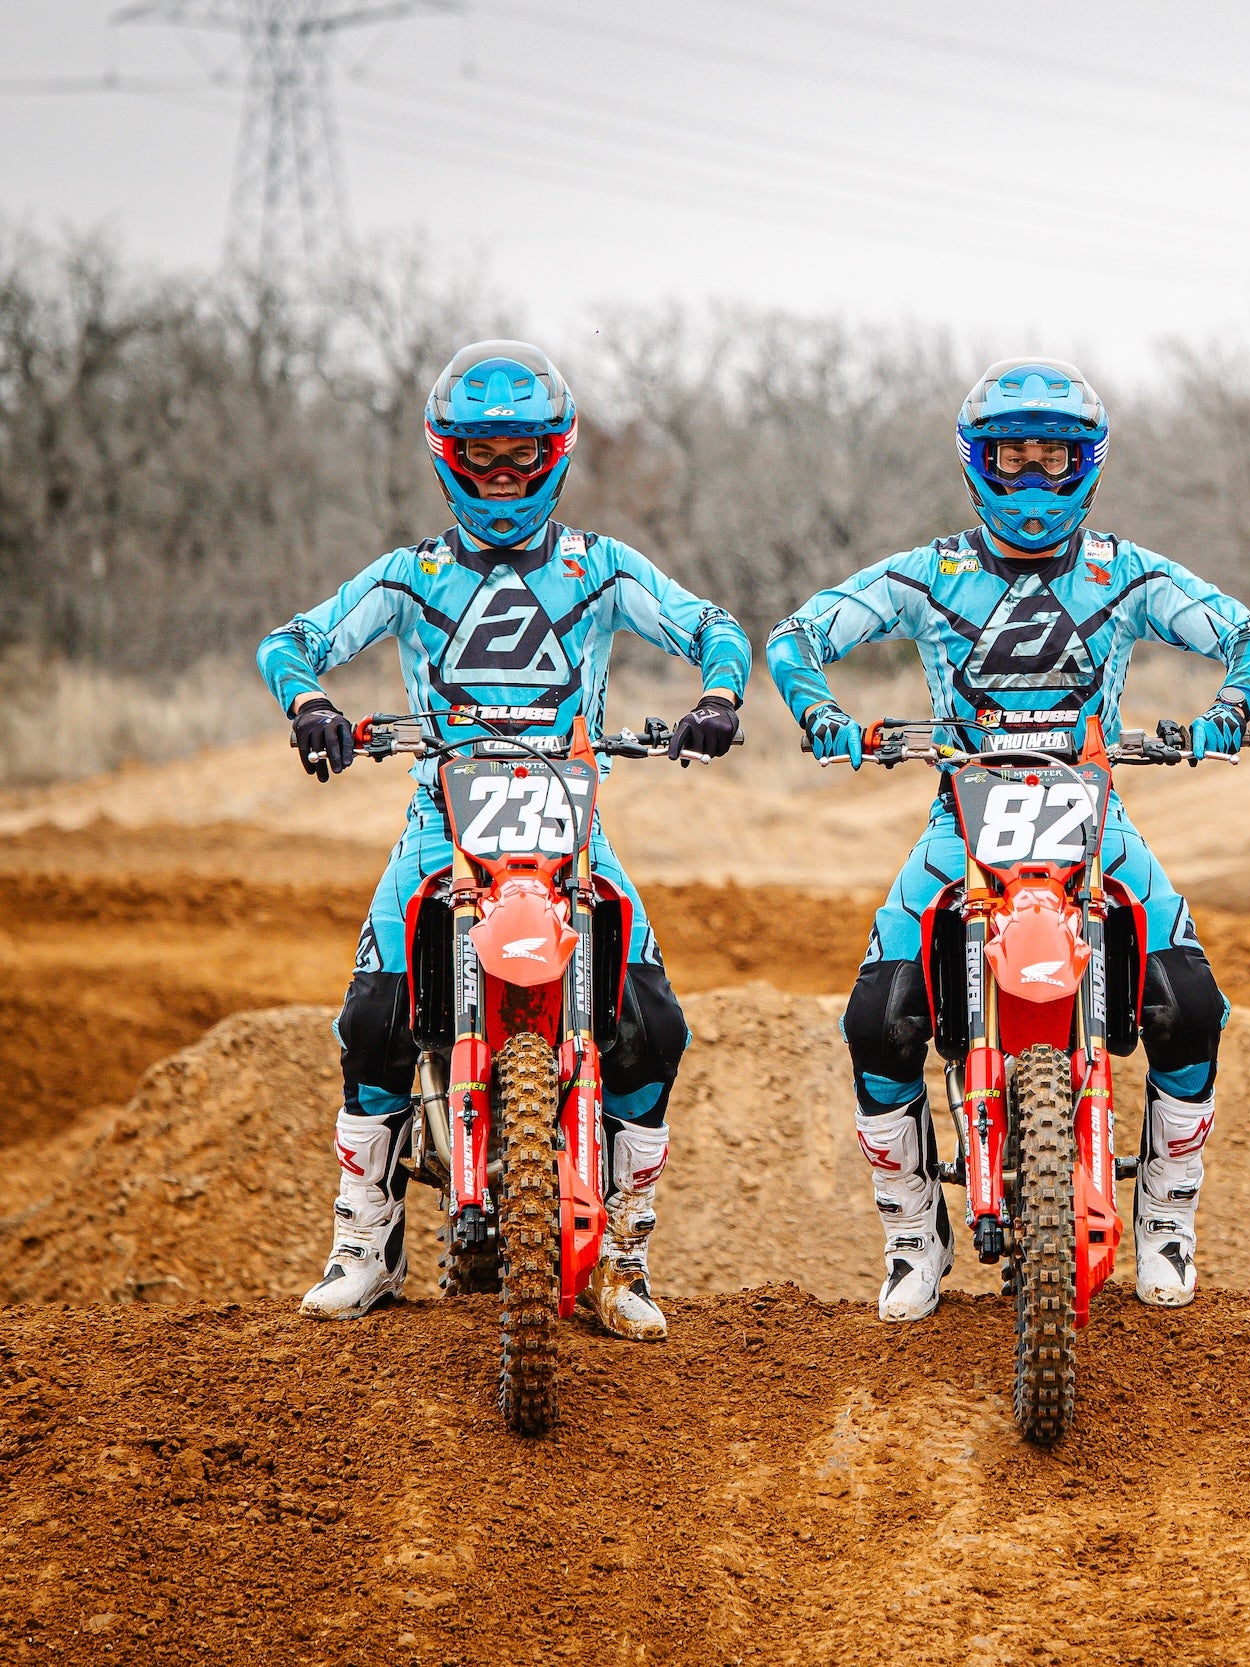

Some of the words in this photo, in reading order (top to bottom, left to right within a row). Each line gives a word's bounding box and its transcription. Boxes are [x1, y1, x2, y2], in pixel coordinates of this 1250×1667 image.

[994, 732, 1062, 750] PROTAPER
[460, 776, 589, 855] 235
[975, 783, 1100, 864] 82
[502, 952, 547, 964] HONDA
[966, 940, 981, 1024] RIVAL
[1020, 976, 1065, 988] HONDA
[1092, 942, 1106, 1023] RIVAL
[451, 1082, 487, 1093] TAMER
[965, 1089, 1001, 1101] TAMER
